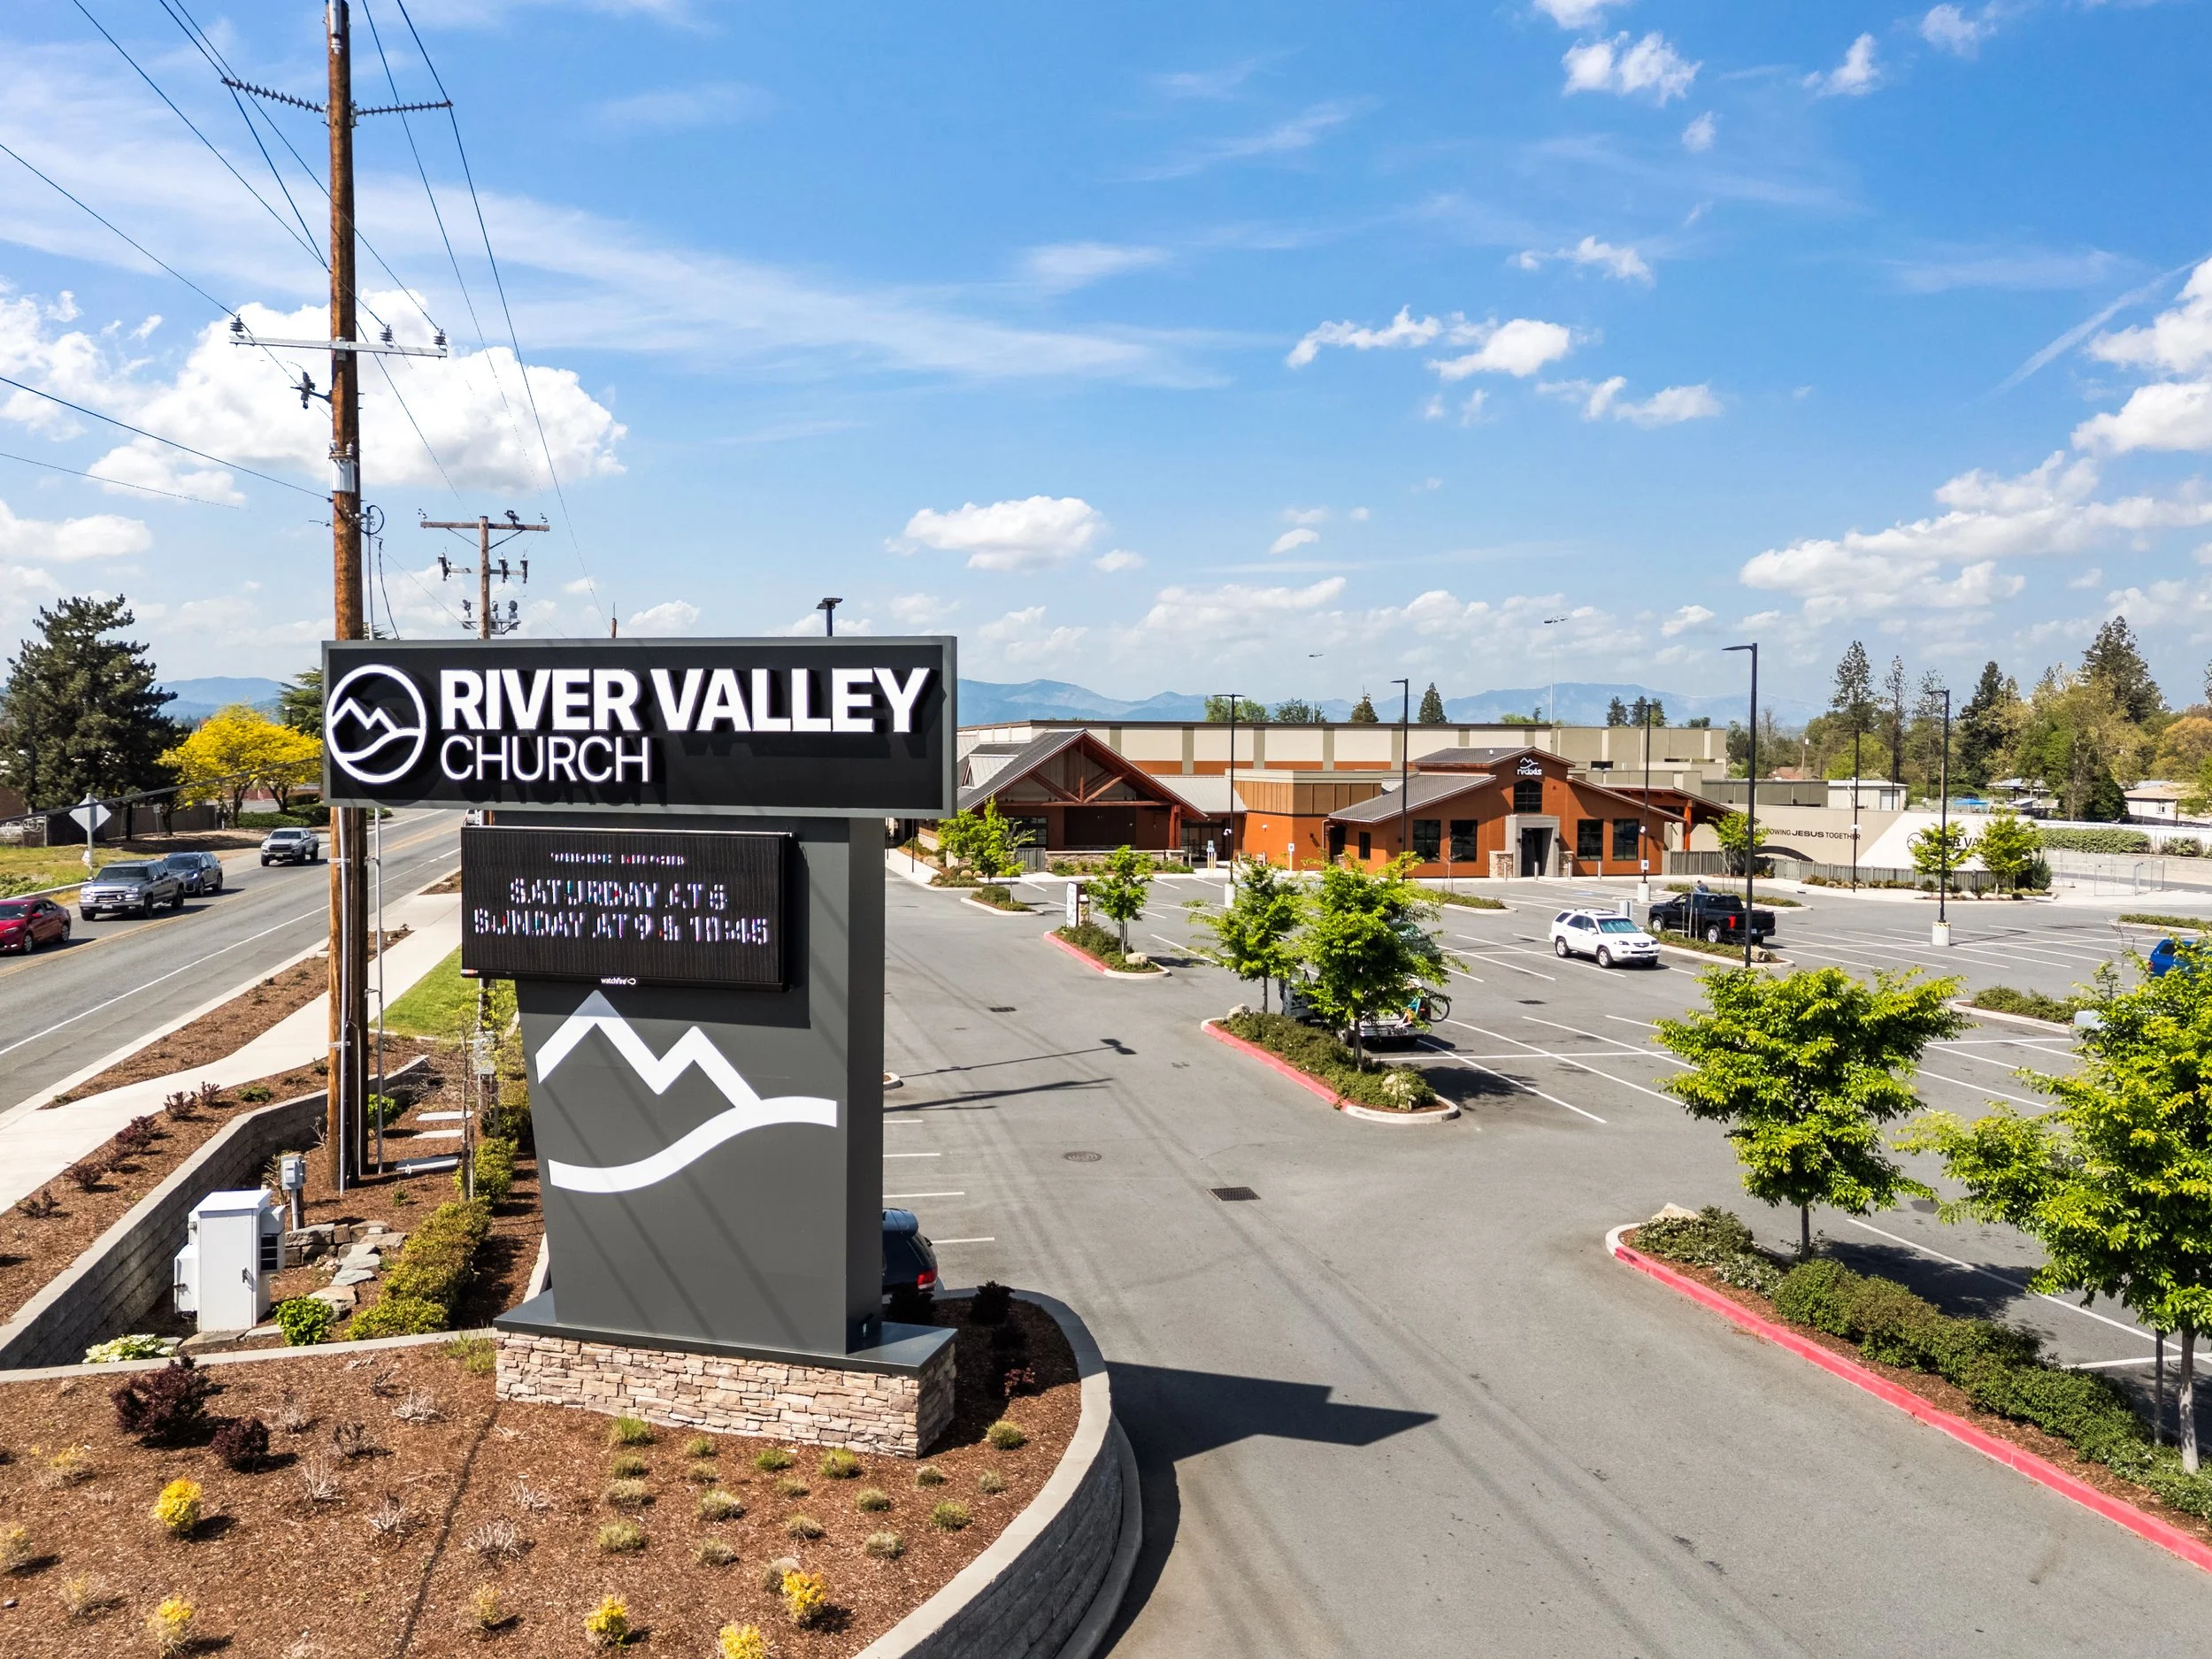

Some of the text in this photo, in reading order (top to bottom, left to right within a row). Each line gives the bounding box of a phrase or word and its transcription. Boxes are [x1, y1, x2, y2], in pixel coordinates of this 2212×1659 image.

[441, 667, 931, 733] RIVER VALLEY
[441, 735, 650, 783] CHURCH
[510, 878, 658, 909] SATURDAY
[664, 882, 703, 910] AT
[473, 907, 584, 937] SUNDAY
[592, 912, 628, 939] AT
